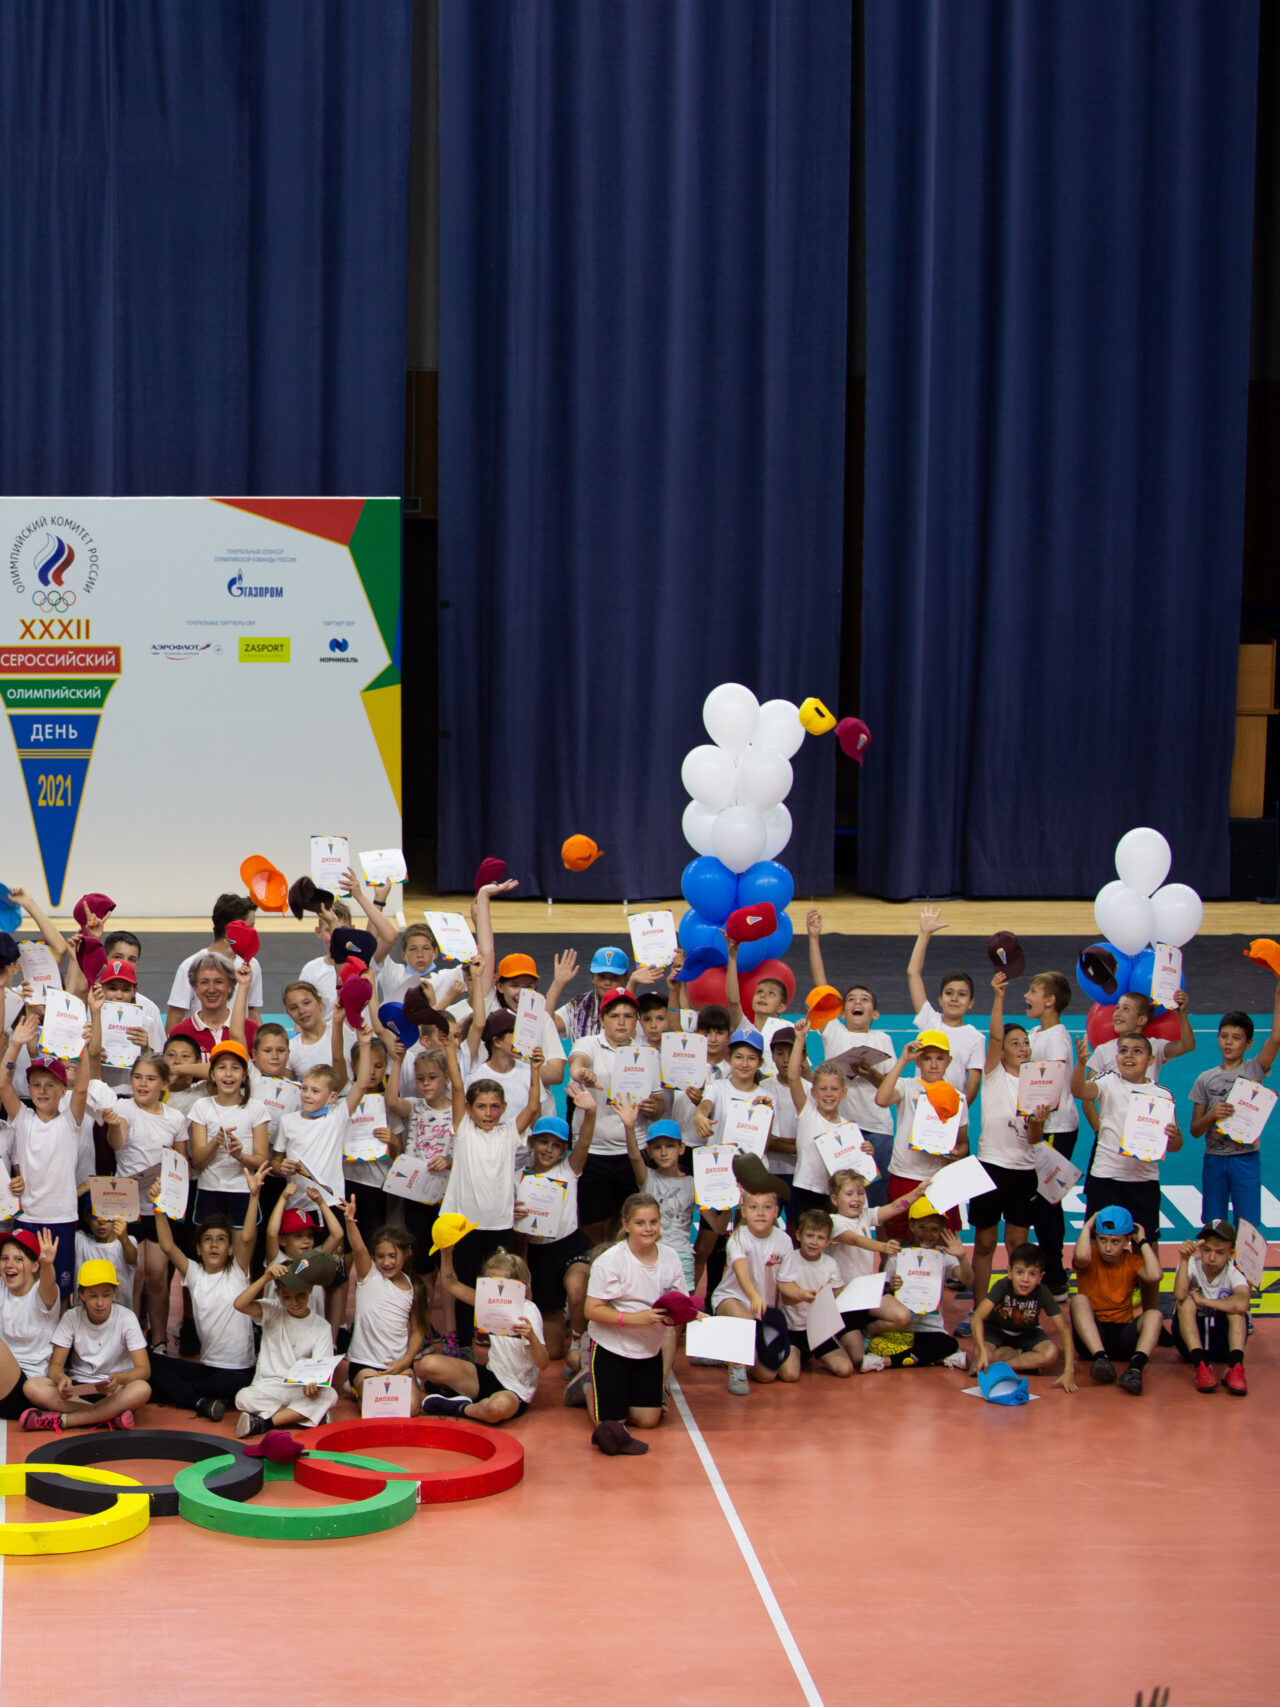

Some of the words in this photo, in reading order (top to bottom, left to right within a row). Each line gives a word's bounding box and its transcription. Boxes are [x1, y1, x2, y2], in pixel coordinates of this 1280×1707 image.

[7, 516, 48, 594] ОЛИМПИЙСКИЙ
[50, 516, 94, 545] КОМИТЕТ
[83, 547, 99, 594] РОССИИ
[244, 586, 284, 598] ГАЗПРОМ
[18, 618, 90, 640] XXXII
[244, 644, 285, 652] ZASPORT
[6, 686, 102, 699] ОЛИМПИЙСКИЙ
[30, 724, 79, 742] ДЕНЬ
[37, 774, 72, 807] 2021
